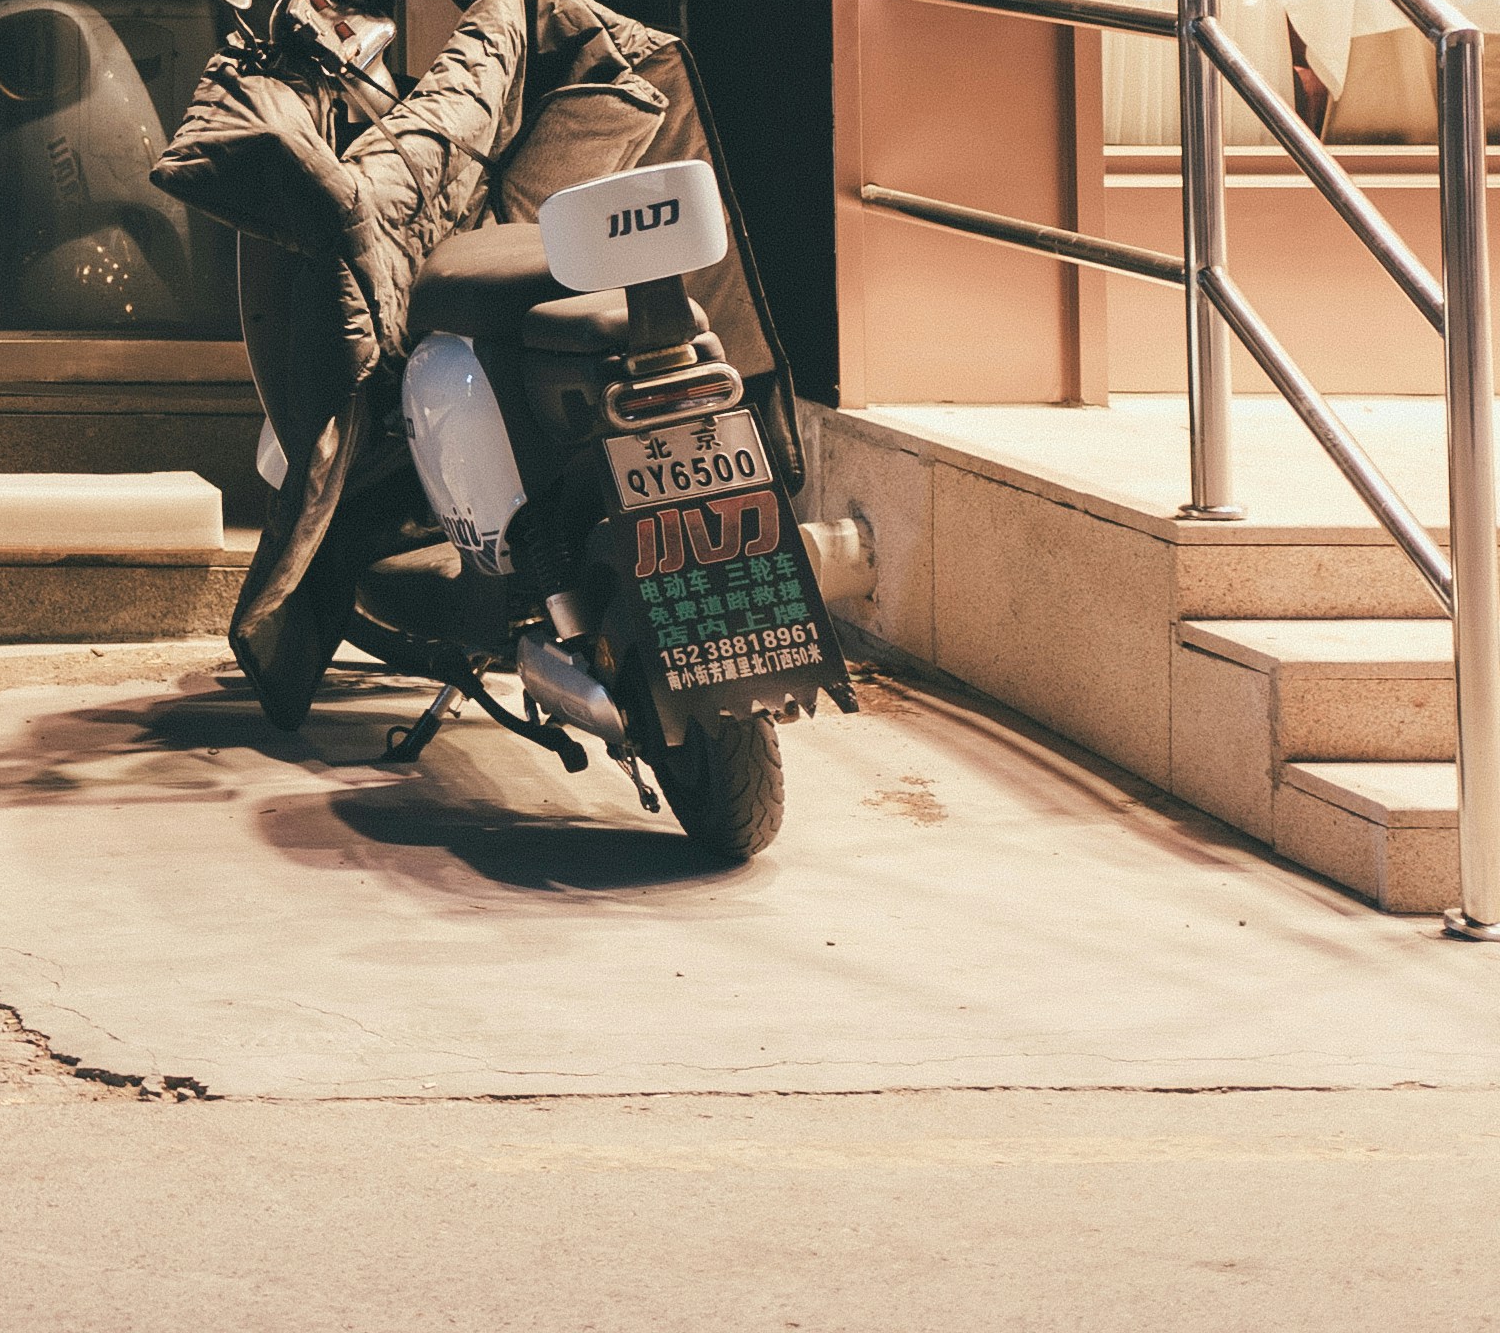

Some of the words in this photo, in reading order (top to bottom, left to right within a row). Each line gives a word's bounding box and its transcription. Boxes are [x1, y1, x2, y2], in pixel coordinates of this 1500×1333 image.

[645, 427, 722, 462] 北京
[626, 448, 757, 499] QY6500
[639, 569, 712, 603] 电动车
[725, 552, 799, 590] 三轮车
[648, 579, 804, 627] 免费道路救援
[657, 601, 811, 648] 店内上牌
